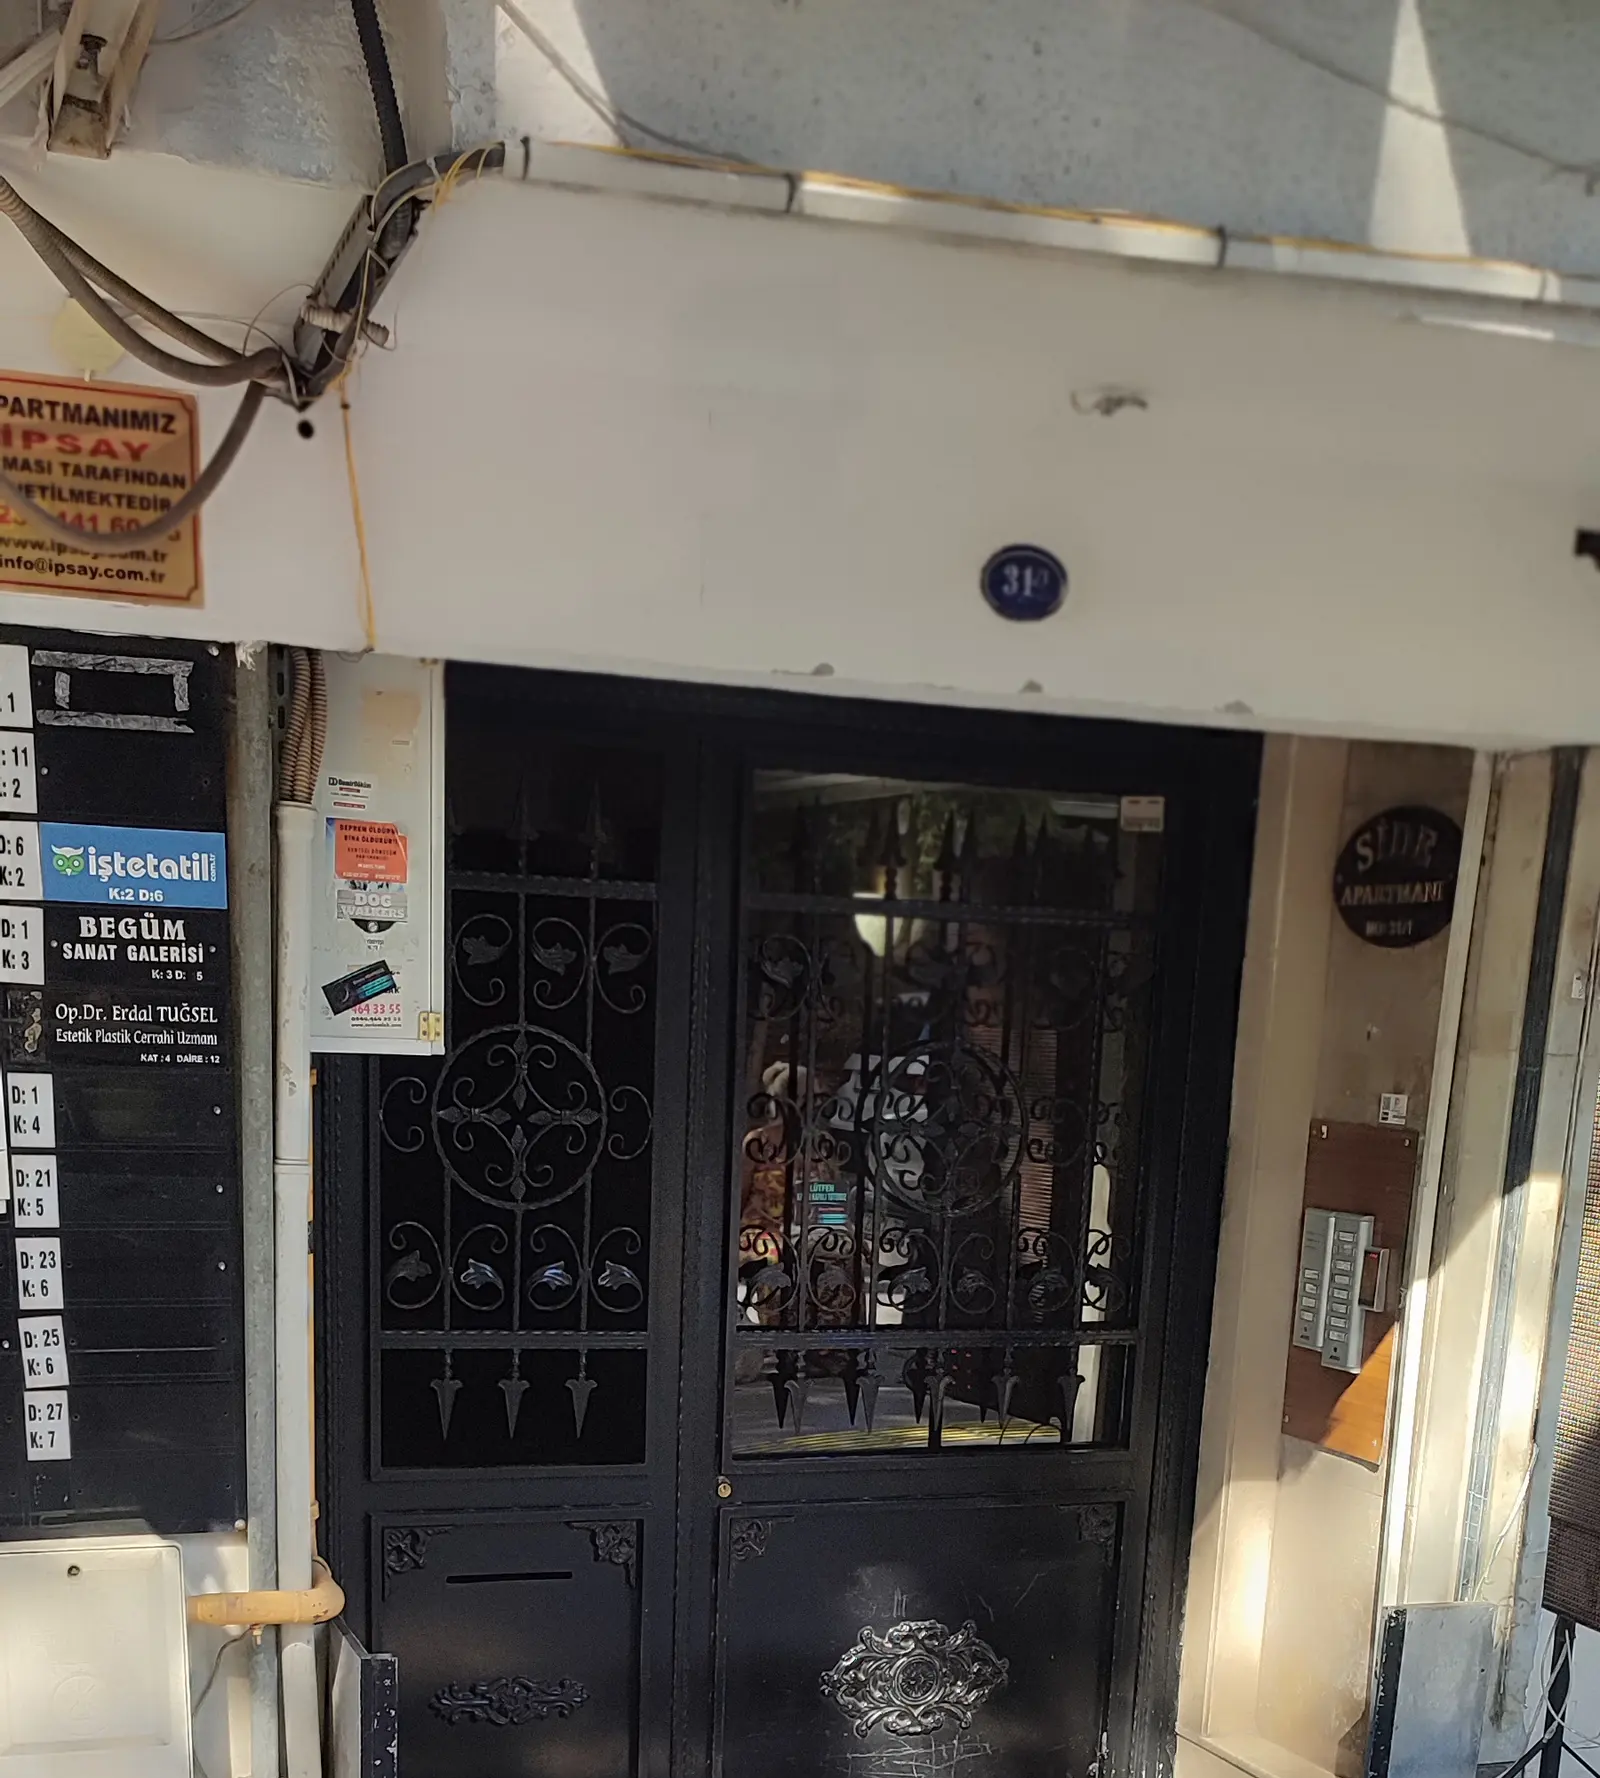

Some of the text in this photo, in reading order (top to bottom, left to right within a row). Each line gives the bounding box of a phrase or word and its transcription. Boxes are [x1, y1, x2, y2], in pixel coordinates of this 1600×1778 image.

[59, 462, 186, 490] TARAFINDAN
[18, 484, 172, 513] ETİLMEKTEDİR
[11, 746, 28, 767] 11
[12, 778, 21, 798] 2
[16, 836, 24, 856] 6
[88, 846, 209, 882] iştetatil
[16, 867, 25, 887] 2
[109, 887, 164, 901] K:2 D:6
[354, 892, 392, 908] DOG
[341, 904, 404, 919] WALKERS
[1, 919, 29, 939] D: 1
[79, 911, 187, 941] BEGÜM
[2, 950, 30, 970] K: 3
[63, 943, 204, 964] SANAT GALERİSİ
[55, 1002, 218, 1025] Op.Dr. Erdal TUĞSEL
[373, 1003, 386, 1015] 33
[389, 1003, 401, 1015] 55
[56, 1028, 218, 1046] Estetik Plastik Cerrahi Uzmanı
[140, 1053, 158, 1062] KAT
[12, 1085, 38, 1104] D: 1
[13, 1116, 40, 1134] K: 4
[16, 1169, 52, 1188] D: 21
[17, 1197, 44, 1217] K: 5
[20, 1251, 56, 1270] D: 23
[22, 1279, 49, 1298] K: 6
[24, 1328, 60, 1349] D: 25
[27, 1357, 54, 1376] K: 6
[28, 1403, 63, 1422] D: 27
[30, 1431, 56, 1449] K: 7
